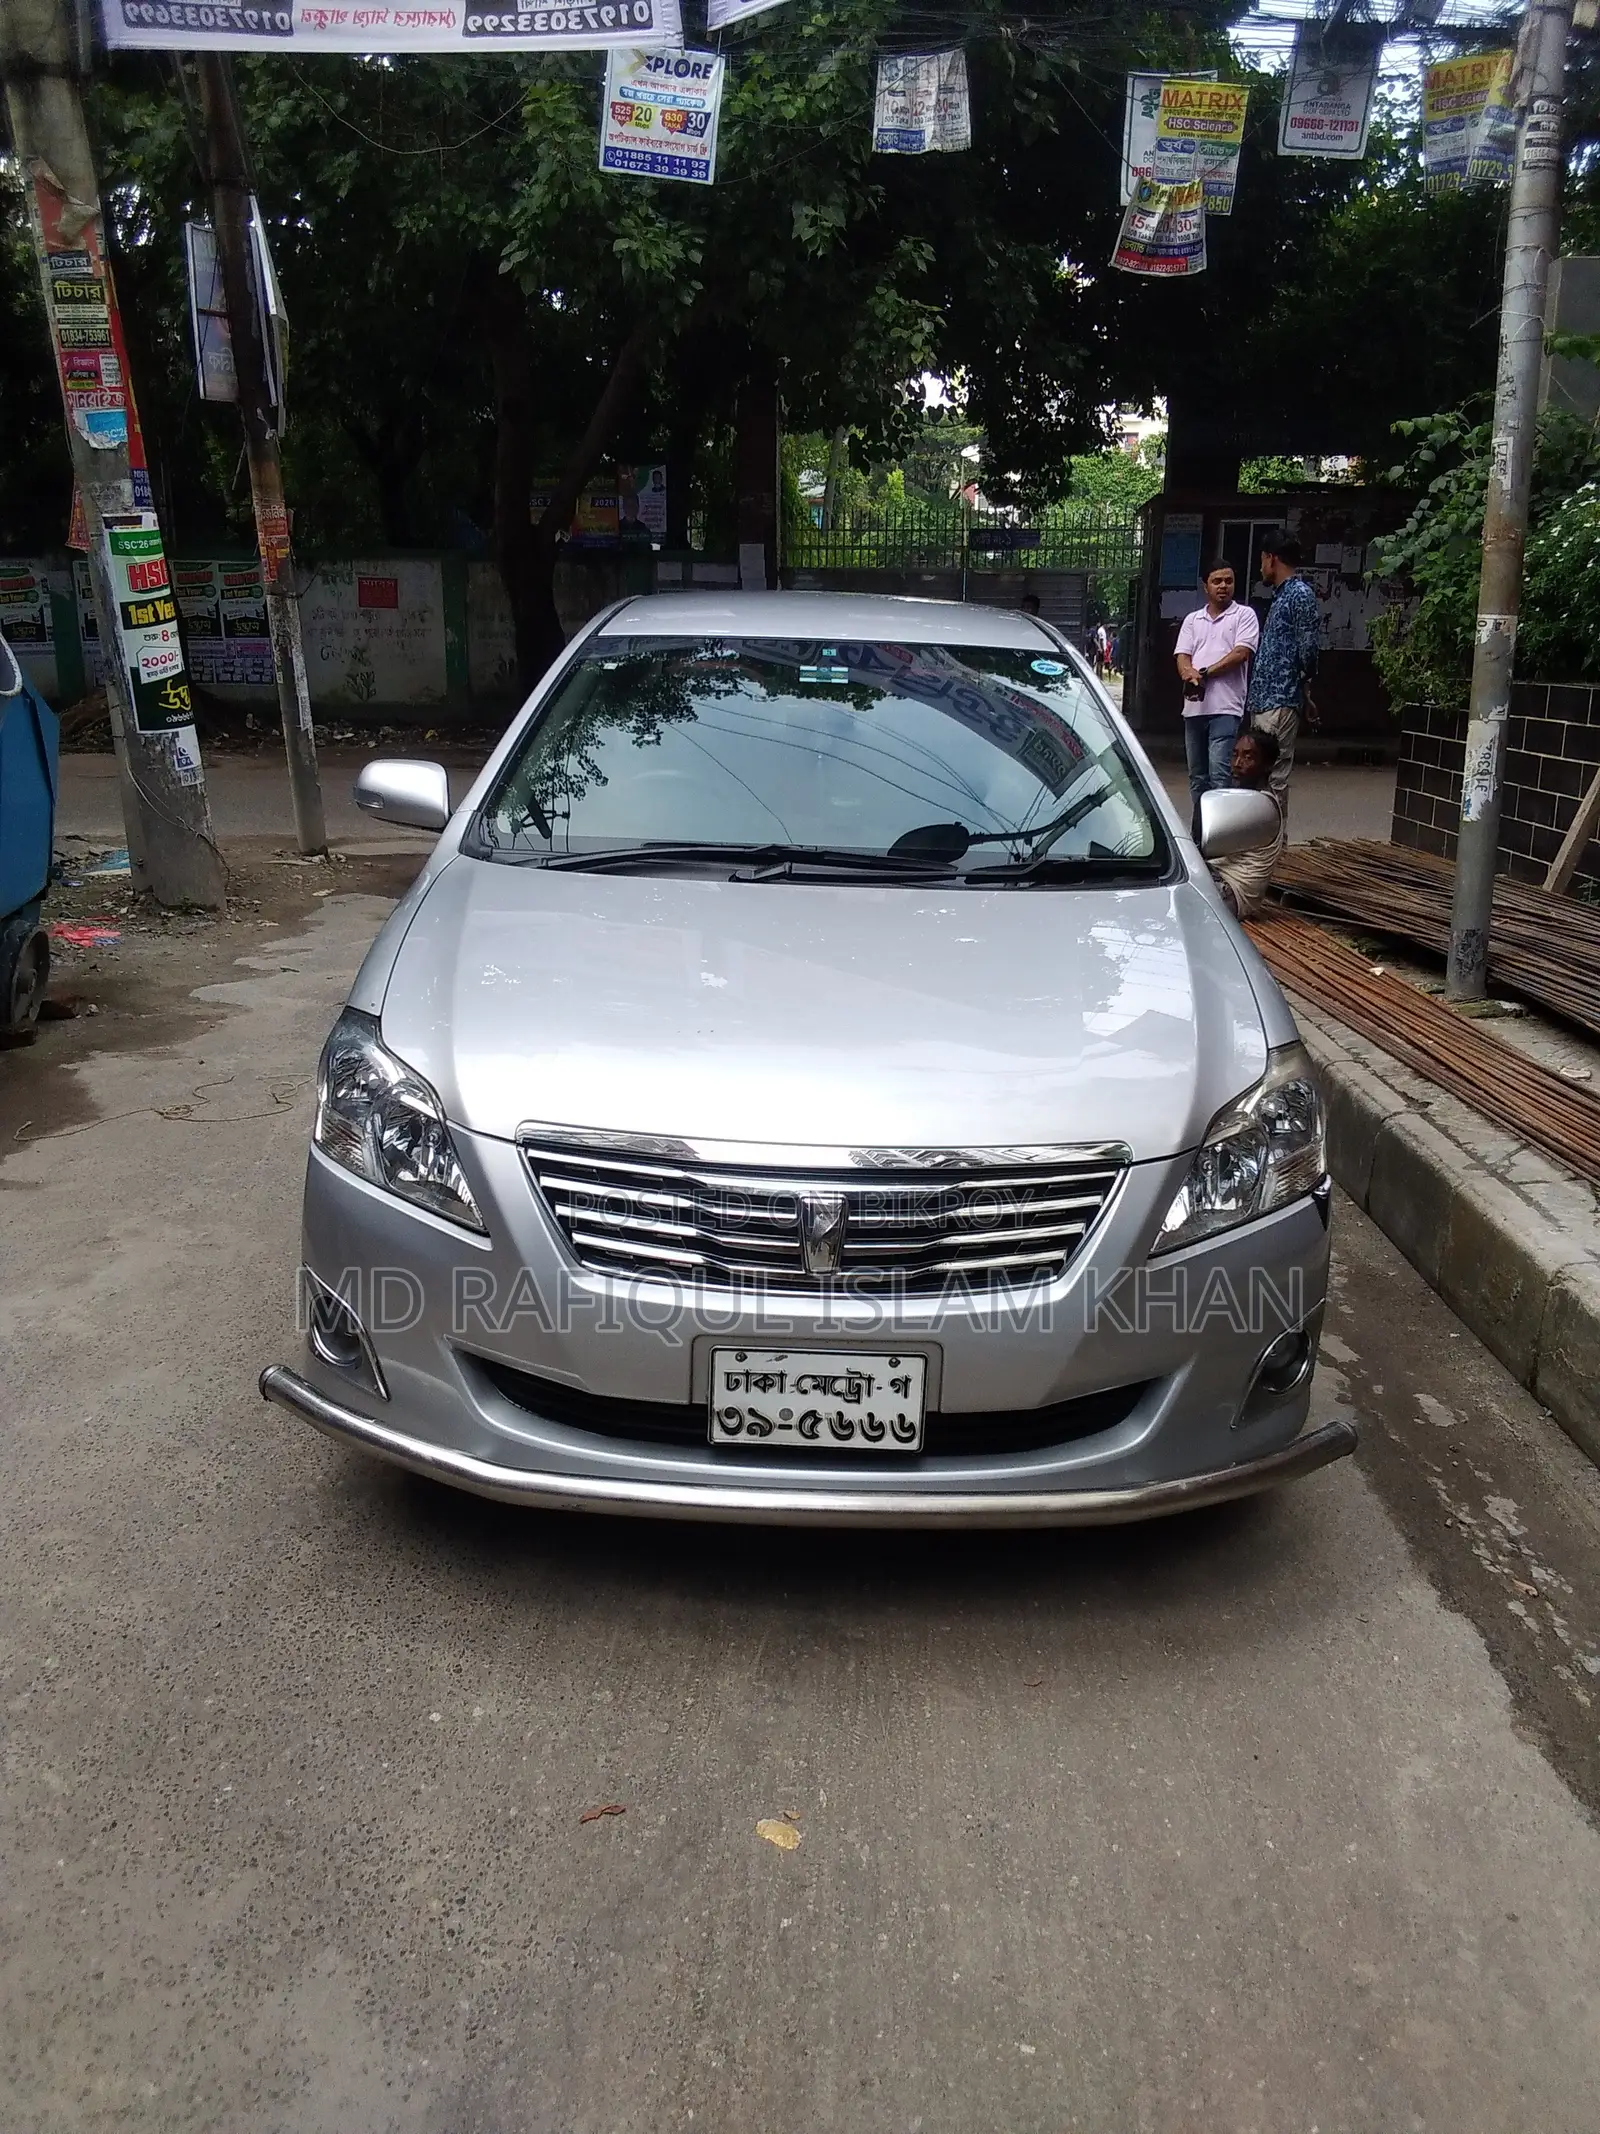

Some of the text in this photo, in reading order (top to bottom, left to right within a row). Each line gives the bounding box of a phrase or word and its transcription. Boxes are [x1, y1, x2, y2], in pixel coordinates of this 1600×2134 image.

[1161, 88, 1245, 112] MATRIX
[615, 104, 632, 115] 525
[635, 106, 652, 122] 20
[664, 112, 683, 122] 630
[688, 112, 705, 129] 30
[1168, 118, 1233, 132] HSC Science
[615, 149, 707, 169] 01885 11 11 92
[614, 160, 706, 178] 01673 39 39 39
[1177, 219, 1192, 233] 30
[54, 280, 102, 299] টিচার
[118, 540, 149, 550] SSC'26
[128, 600, 156, 625] 1st
[724, 1369, 788, 1395] ঢাকা
